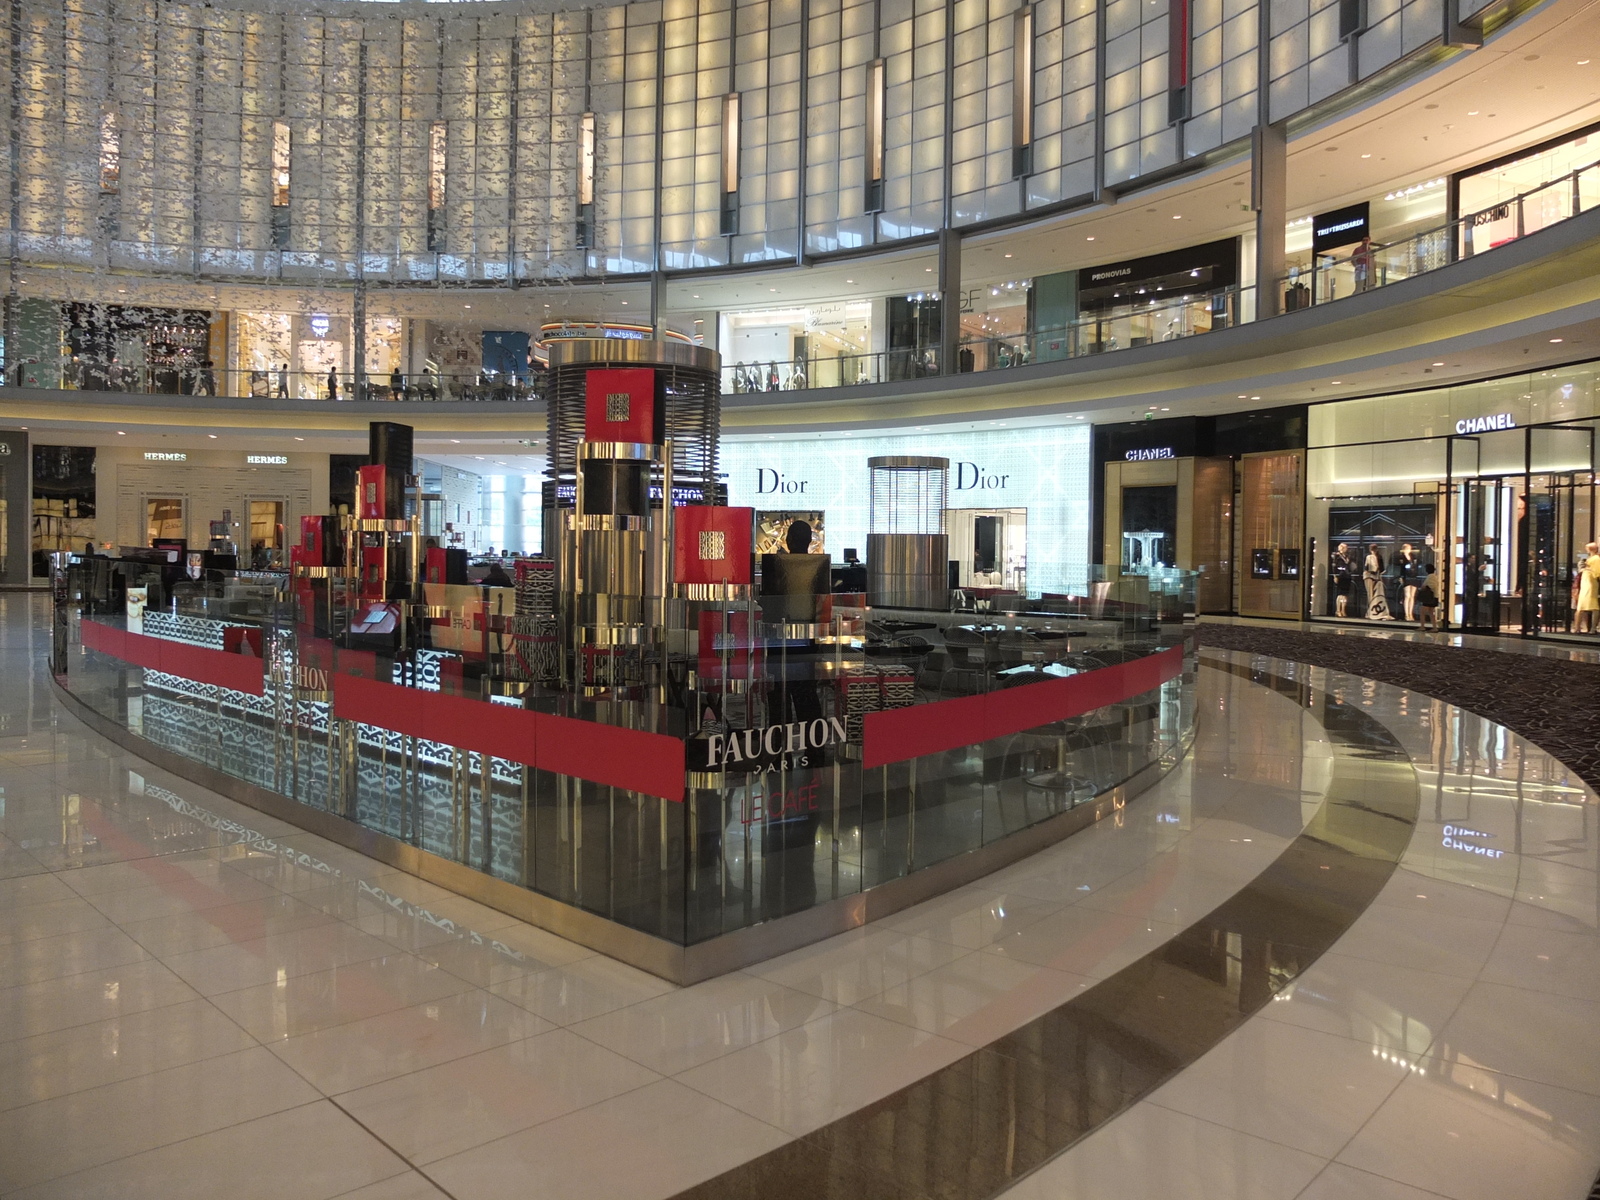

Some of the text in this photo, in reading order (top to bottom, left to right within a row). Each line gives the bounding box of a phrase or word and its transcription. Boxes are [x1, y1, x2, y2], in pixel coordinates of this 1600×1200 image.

[1092, 268, 1132, 281] PRONOVIAS
[1455, 413, 1516, 434] CHANEL
[1125, 447, 1175, 461] CHANEL
[755, 468, 808, 494] Dior
[954, 461, 1009, 490] Dior
[706, 714, 849, 767] FAUCHON
[740, 780, 820, 824] LE CAFÉ
